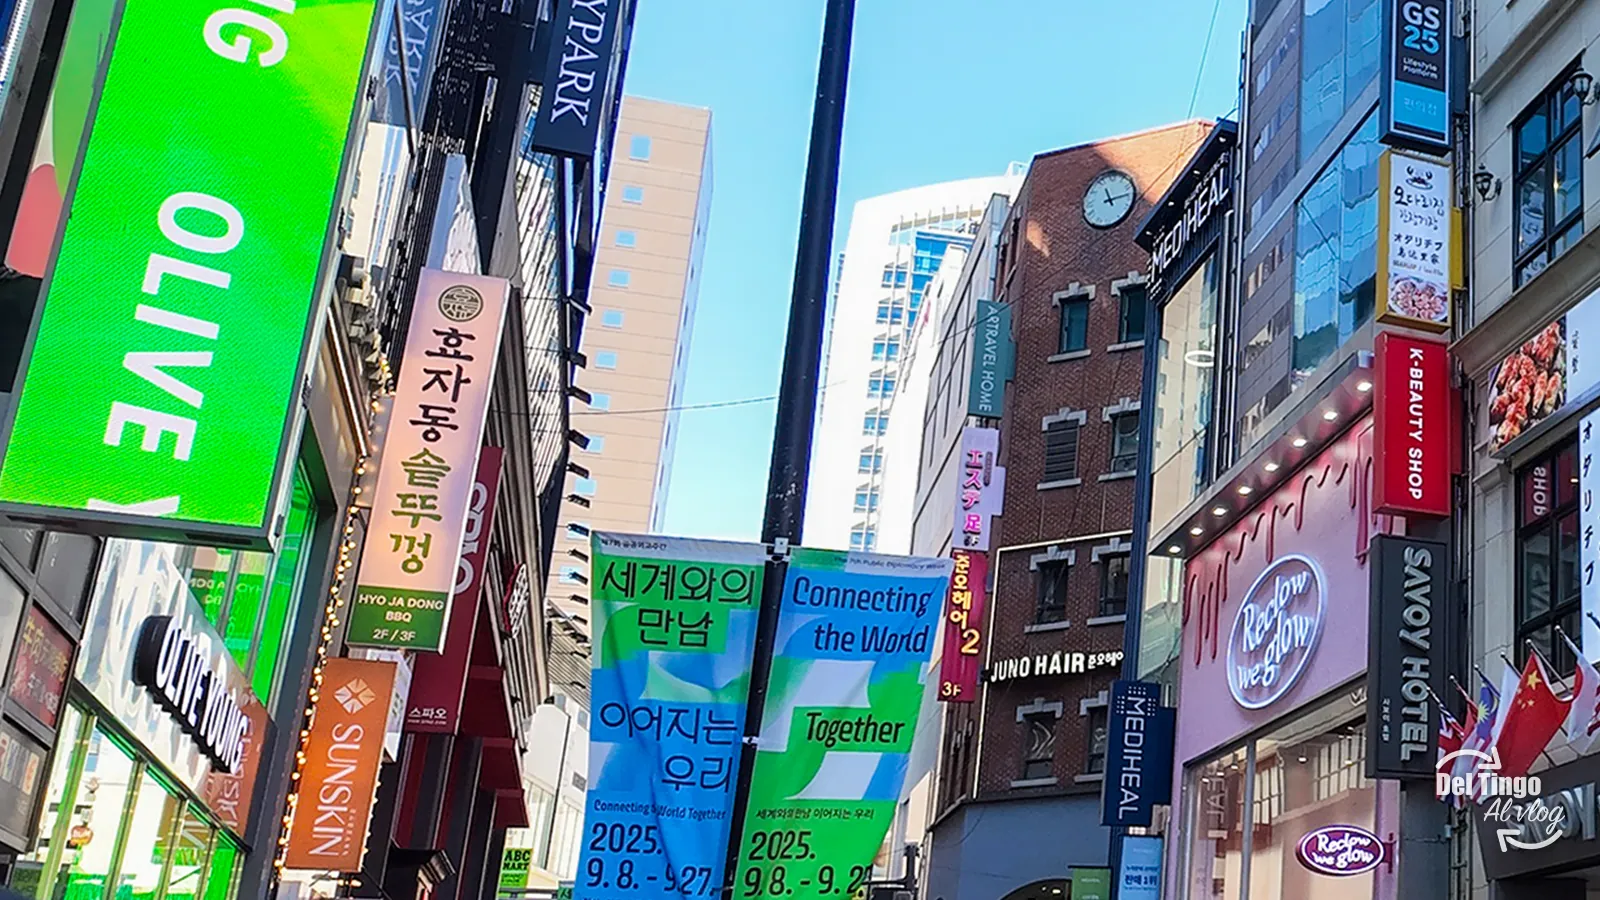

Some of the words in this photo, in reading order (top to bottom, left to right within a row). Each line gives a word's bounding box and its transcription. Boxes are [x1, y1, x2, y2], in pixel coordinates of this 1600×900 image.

[1403, 1, 1440, 29] GS
[1404, 25, 1440, 54] 25
[550, 0, 607, 126] YPARK
[1403, 57, 1437, 71] Lifestyle
[1403, 65, 1438, 79] Platform
[1151, 167, 1229, 284] MEDIHEAL
[103, 191, 245, 461] OLIVE
[983, 305, 999, 368] ARTRAVEL
[979, 371, 995, 412] HOME
[1409, 348, 1424, 442] K-BEAUTY
[1409, 447, 1423, 500] SHOP
[358, 594, 387, 605] HYO
[388, 597, 405, 607] JA
[407, 597, 445, 610] DONG
[601, 561, 757, 606] 세계와의
[792, 576, 934, 616] Connecting
[1399, 546, 1433, 650] SAVOY
[372, 628, 390, 640] 2F
[400, 630, 416, 641] 3F
[385, 611, 413, 623] BBQ
[637, 608, 714, 648] 만남
[814, 623, 855, 651] the
[861, 625, 931, 653] World
[1237, 664, 1262, 689] we
[1262, 610, 1314, 687] glow
[990, 656, 1031, 682] JUNO
[1034, 652, 1085, 676] HAIR
[156, 615, 209, 728] OLIVE
[200, 669, 249, 776] YOUNG
[408, 707, 447, 719] 스파오
[1401, 656, 1431, 761] HOTEL
[600, 702, 738, 748] 이어지는
[806, 712, 906, 748] Together
[661, 755, 734, 793] 우리
[1118, 696, 1147, 820] MEDIHEAL
[308, 722, 364, 857] SUNSKIN
[594, 799, 650, 816] Connecting
[688, 807, 727, 822] Together
[813, 808, 851, 820] 이어지는
[854, 809, 875, 820] 우리
[504, 850, 531, 862] ABC
[590, 822, 662, 855] 2025.
[748, 830, 816, 861] 2025.
[1312, 851, 1335, 866] we
[1335, 845, 1375, 869] glow
[502, 862, 530, 871] MART
